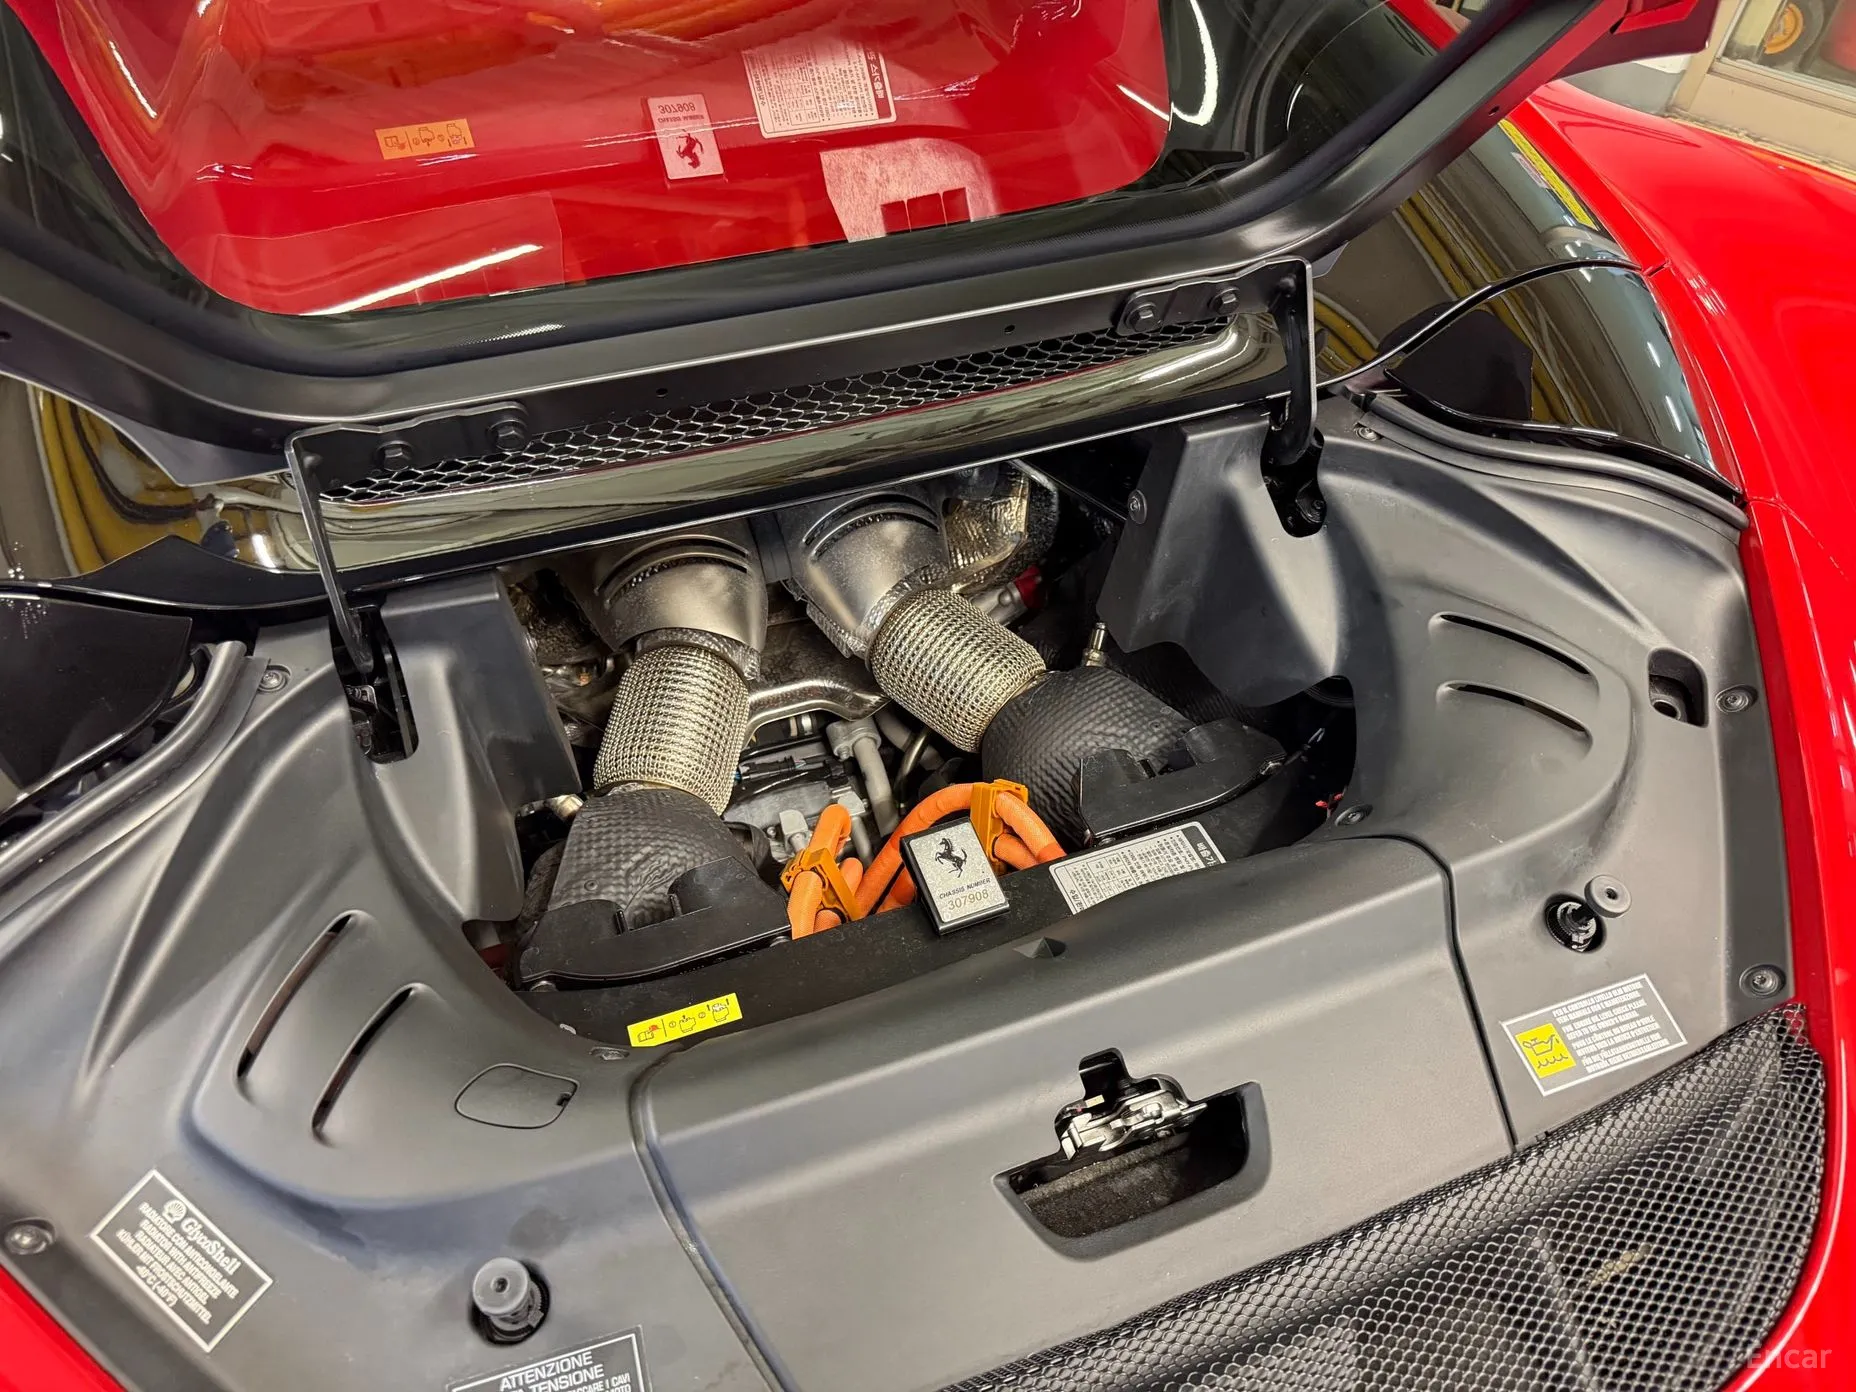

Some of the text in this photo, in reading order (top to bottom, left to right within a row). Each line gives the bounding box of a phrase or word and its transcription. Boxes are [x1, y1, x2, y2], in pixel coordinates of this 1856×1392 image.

[1194, 841, 1218, 867] 배출가
[939, 878, 990, 899] CHASSIS NUMBER
[948, 889, 989, 910] 307908
[180, 1217, 241, 1275] GlycoShell
[166, 1262, 185, 1280] AVEC
[500, 1351, 594, 1391] ATTENZIONE
[611, 1373, 631, 1387] CAVI
